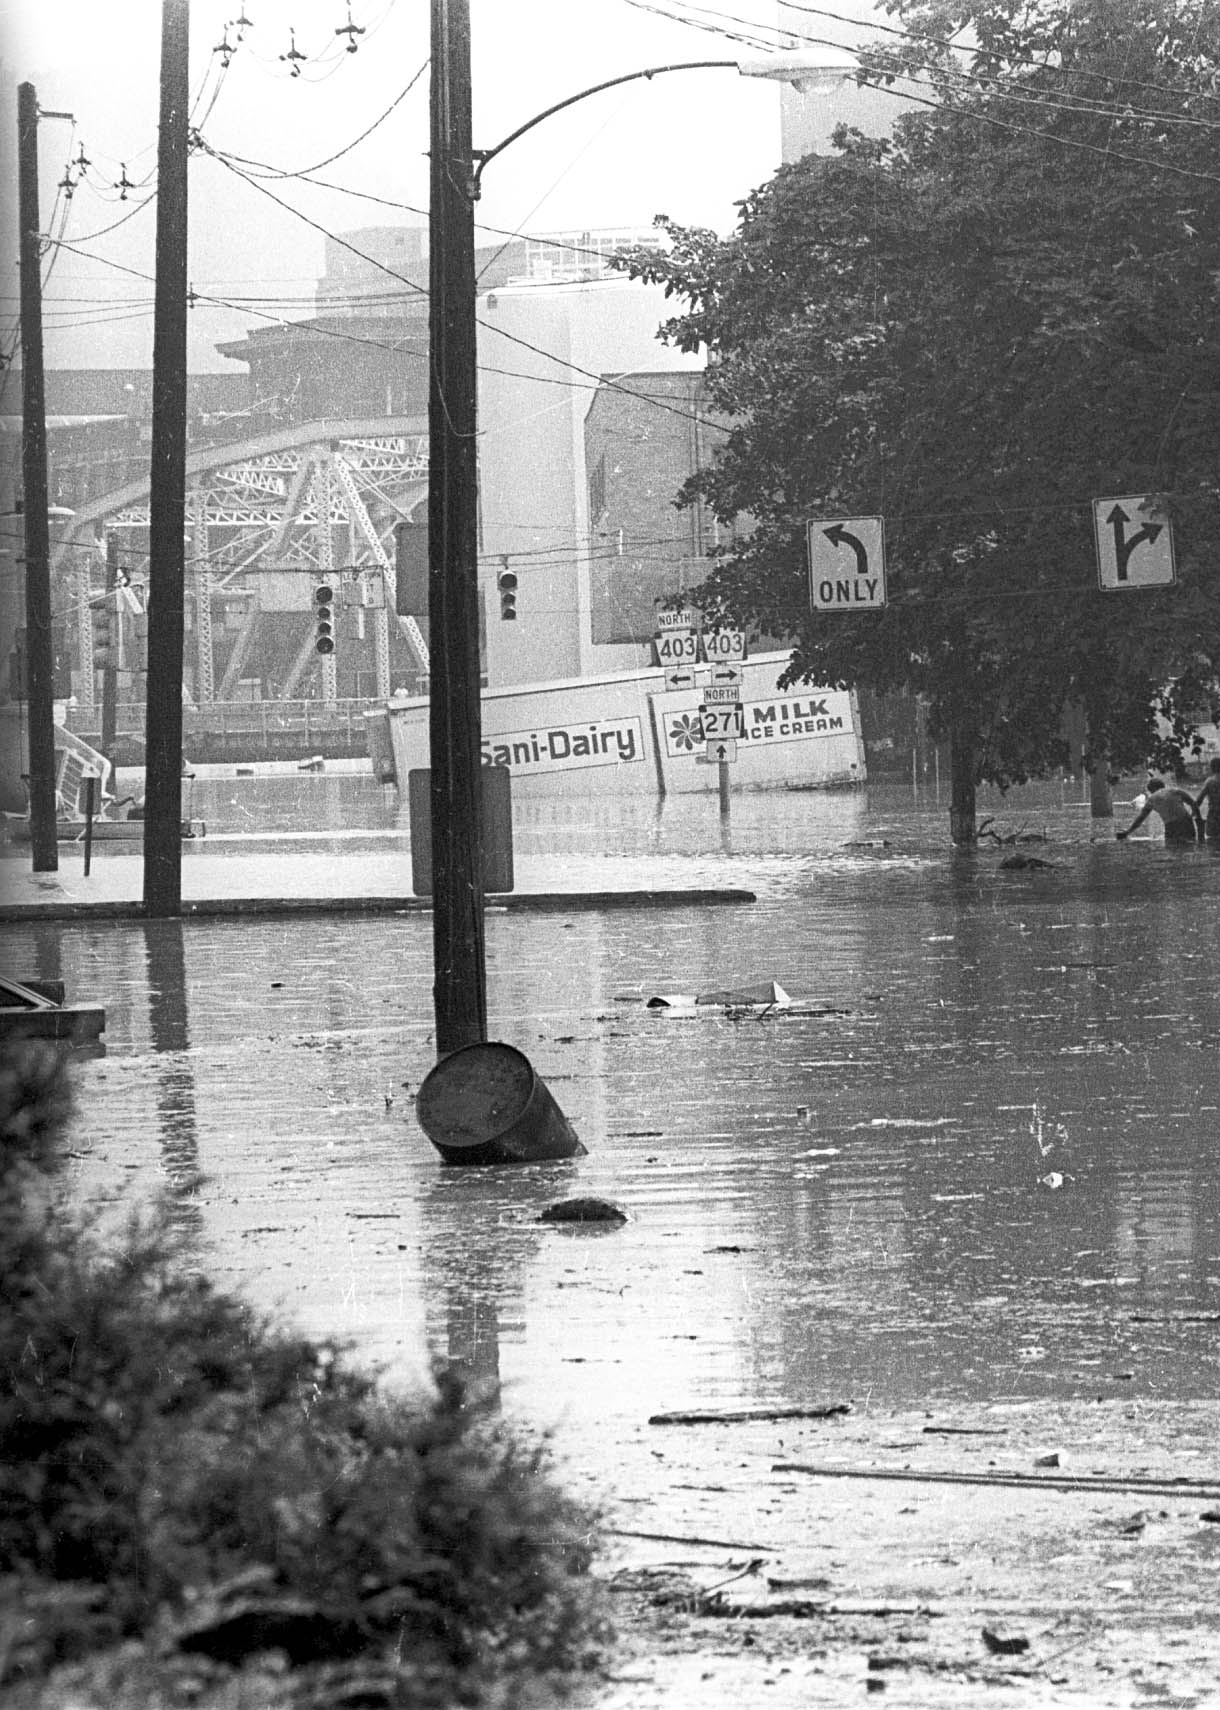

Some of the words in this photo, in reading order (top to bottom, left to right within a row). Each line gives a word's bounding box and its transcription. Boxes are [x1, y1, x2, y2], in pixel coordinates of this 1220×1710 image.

[820, 578, 878, 602] ONLY
[659, 613, 691, 626] NORTH
[660, 636, 696, 657] 403
[707, 633, 743, 654] 403
[705, 689, 737, 701] NORTH
[753, 699, 830, 724] MILK
[704, 712, 740, 733] 271
[779, 716, 844, 736] CREAM
